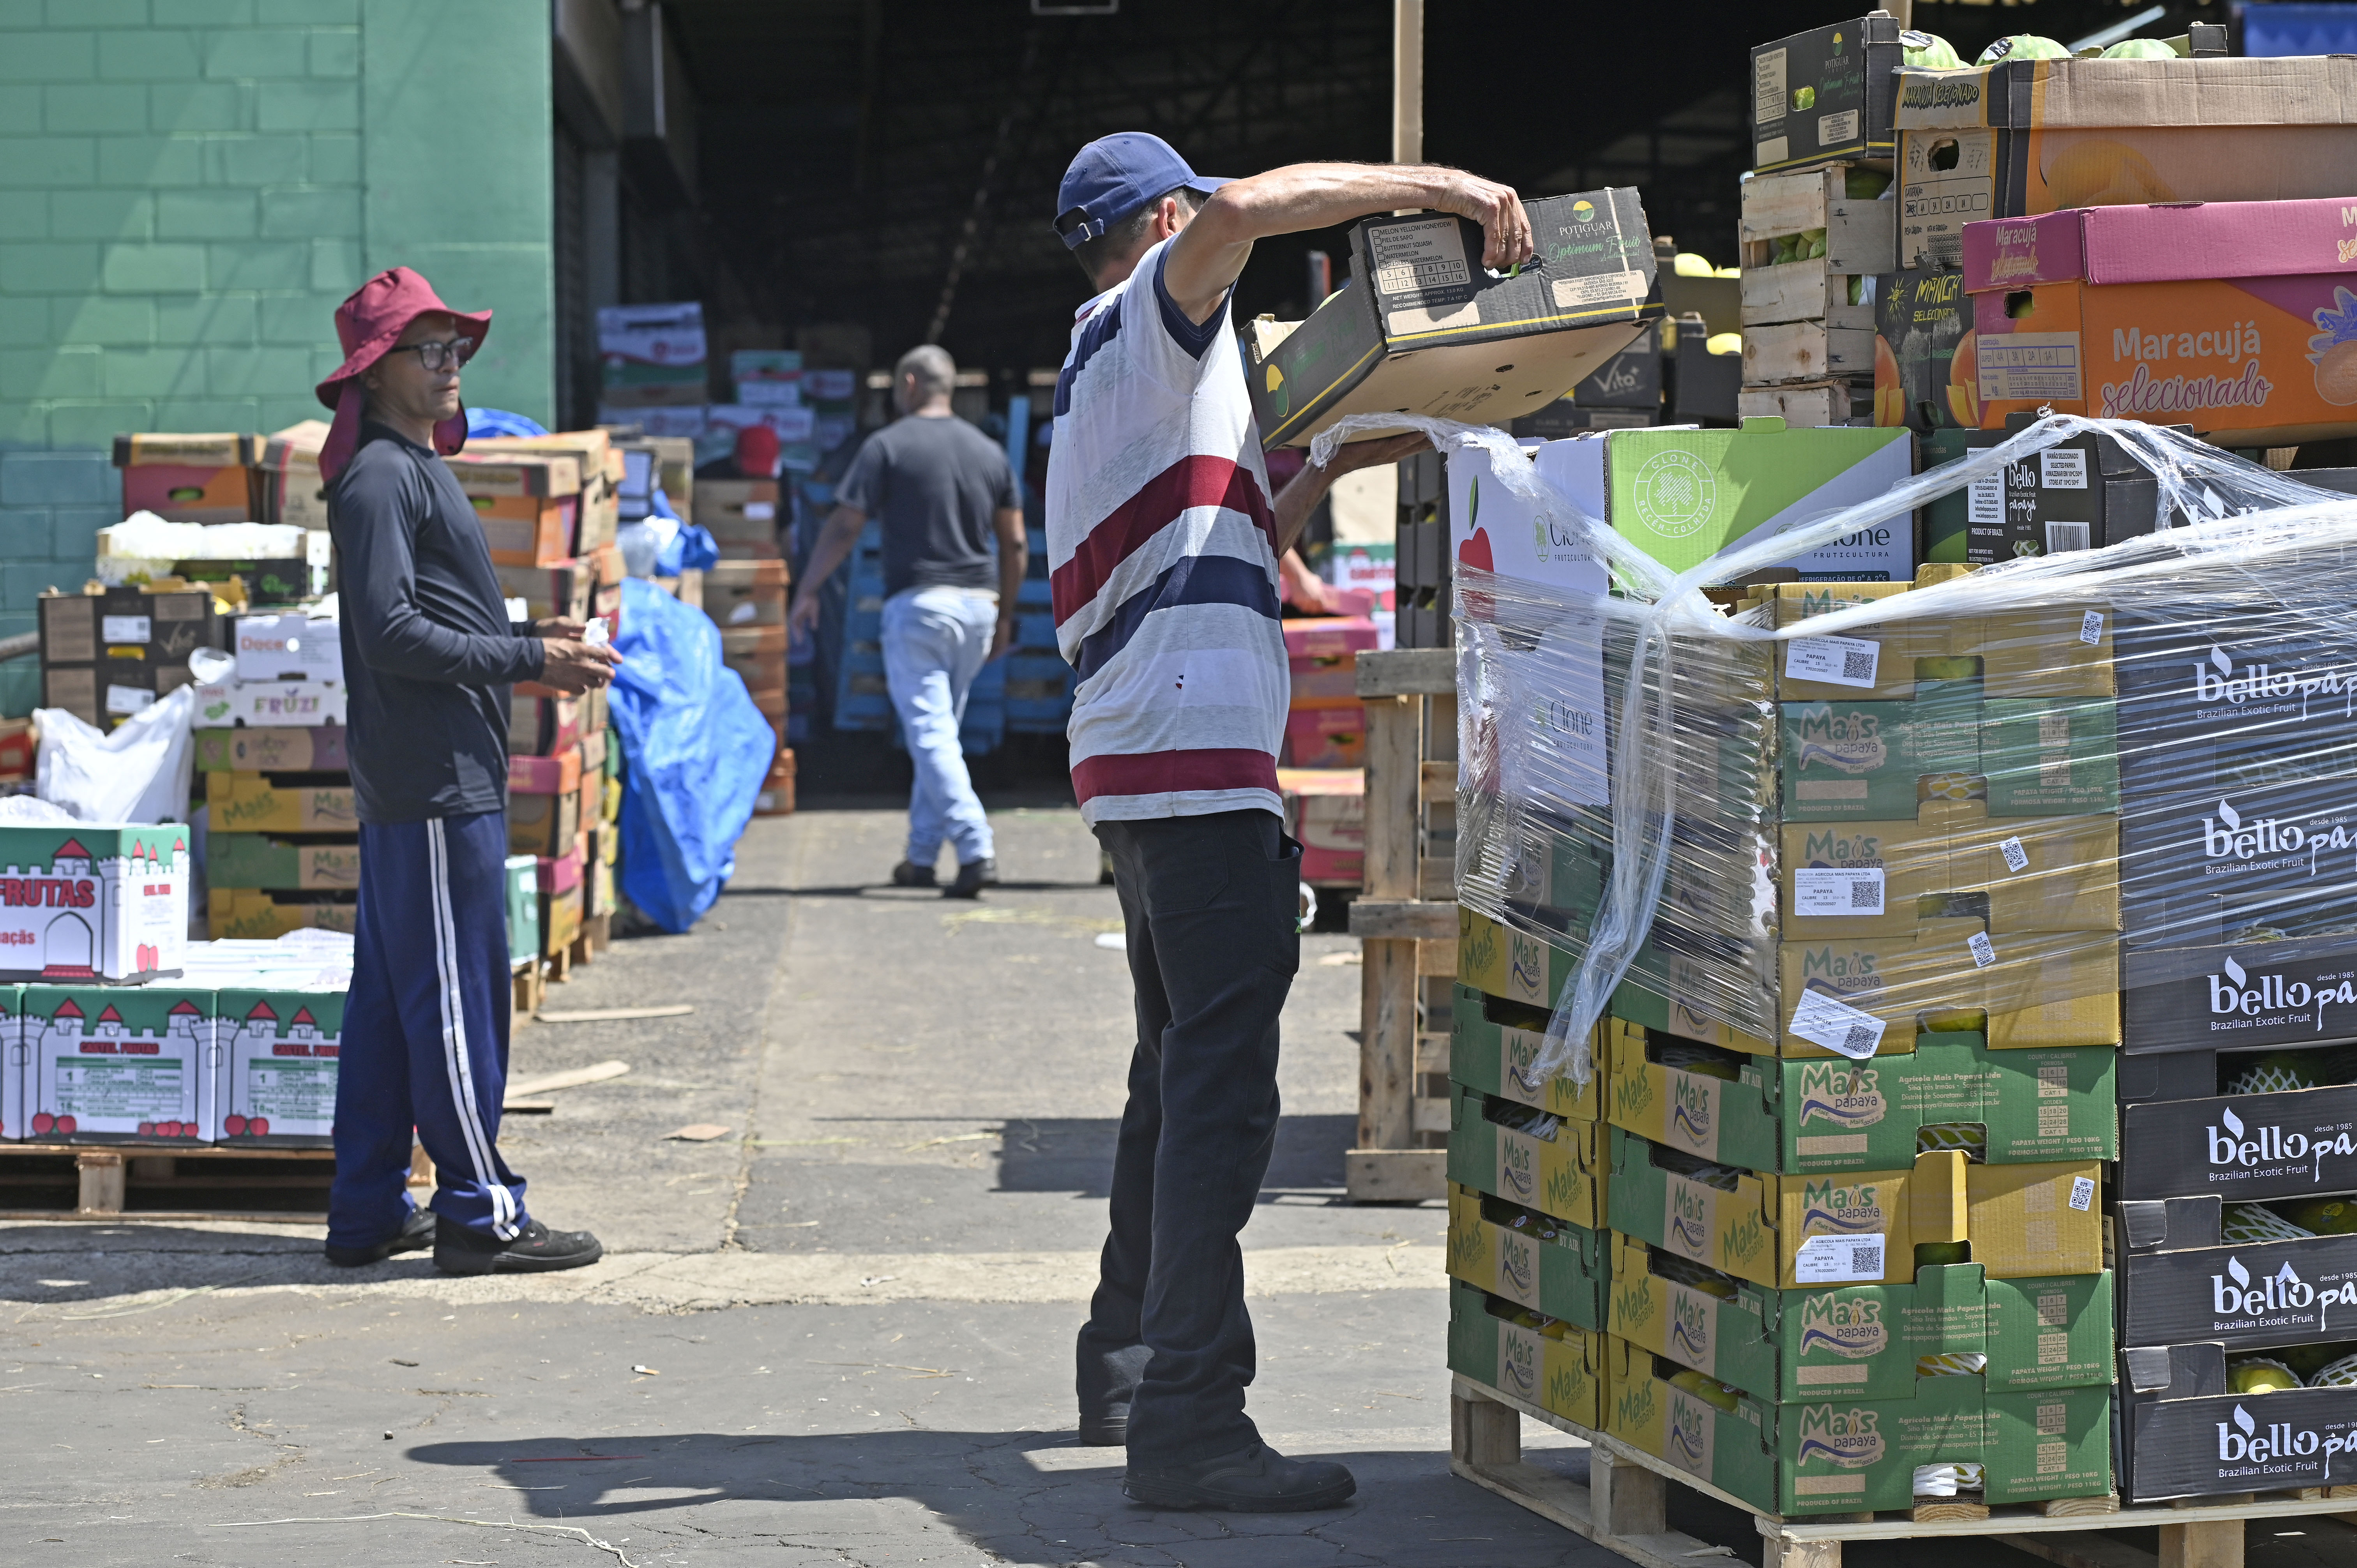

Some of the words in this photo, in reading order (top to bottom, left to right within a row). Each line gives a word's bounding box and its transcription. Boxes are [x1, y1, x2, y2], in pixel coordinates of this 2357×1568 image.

[1825, 56, 1849, 69] POTIGUAR
[1422, 221, 1451, 230] HONEYDEW
[1559, 221, 1613, 235] POTIGUAR
[1568, 231, 1606, 240] FRUIT
[1996, 222, 2036, 247] Maracujá
[1385, 251, 1419, 259] WATERMELON
[1548, 242, 1604, 262] Optimum
[1606, 233, 1640, 254] Fruit
[1410, 255, 1443, 264] WATERMELON
[1915, 274, 1963, 304] MANGA
[1393, 300, 1431, 308] RECOMMENDED
[2113, 320, 2261, 363] Maracujá
[1997, 352, 2004, 361] 4A
[2012, 352, 2019, 361] 3A
[2028, 351, 2035, 360] 2A
[2045, 351, 2052, 361] 1A
[2102, 359, 2271, 418] selecionado
[1651, 454, 1699, 470] CLONE
[2009, 464, 2035, 489] bello
[1638, 497, 1712, 534] RECÉM-COLHIDA
[2009, 499, 2036, 521] papaya
[1551, 701, 1593, 735] Clone
[2202, 818, 2304, 859] bello
[1838, 976, 1880, 988] papaya
[2207, 975, 2311, 1015] bello
[2211, 1018, 2252, 1031] Brazilian
[2256, 1016, 2285, 1027] Exotic
[2289, 1013, 2311, 1023] Fruit
[1741, 1069, 1751, 1084] BY
[1751, 1072, 1762, 1088] AIR
[1836, 1096, 1877, 1109] papaya
[1689, 1110, 1709, 1125] papaya
[2205, 1126, 2308, 1167] bello
[1838, 1207, 1879, 1219] papaya
[2211, 1275, 2314, 1315] bello
[1837, 1326, 1878, 1338] papaya
[1834, 1436, 1876, 1448] papaya
[2216, 1422, 2319, 1462] bello
[2219, 1466, 2260, 1478] Brazilian
[2263, 1463, 2292, 1474] Exotic
[2296, 1461, 2318, 1471] Fruit
